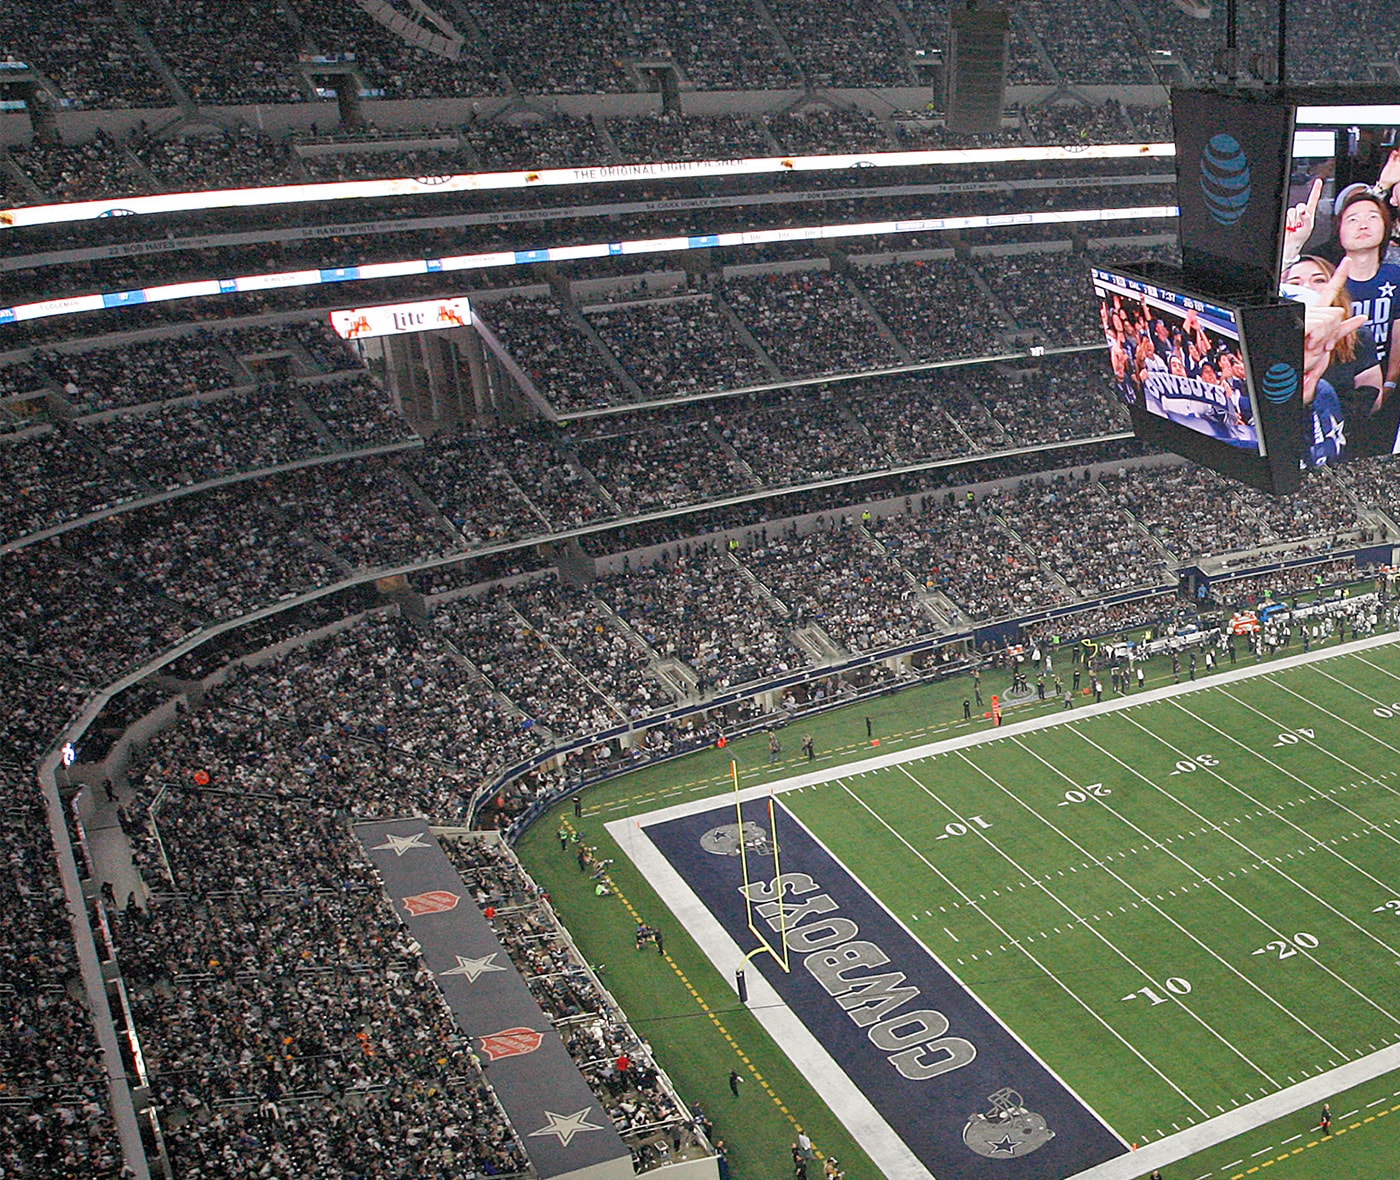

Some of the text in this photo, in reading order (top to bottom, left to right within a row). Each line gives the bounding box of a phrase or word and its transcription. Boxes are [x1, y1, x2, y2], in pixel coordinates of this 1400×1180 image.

[573, 169, 596, 180] THE
[599, 164, 656, 177] ORIGINAL
[660, 162, 693, 173] LIGHT
[1145, 371, 1227, 407] COWBOYS
[1278, 728, 1315, 744] 40
[1175, 754, 1219, 772] 30
[1065, 783, 1111, 803] 20
[945, 815, 993, 836] 10
[1266, 932, 1319, 959] 20
[737, 871, 978, 1081] COWBOYS
[1137, 977, 1191, 1006] 10
